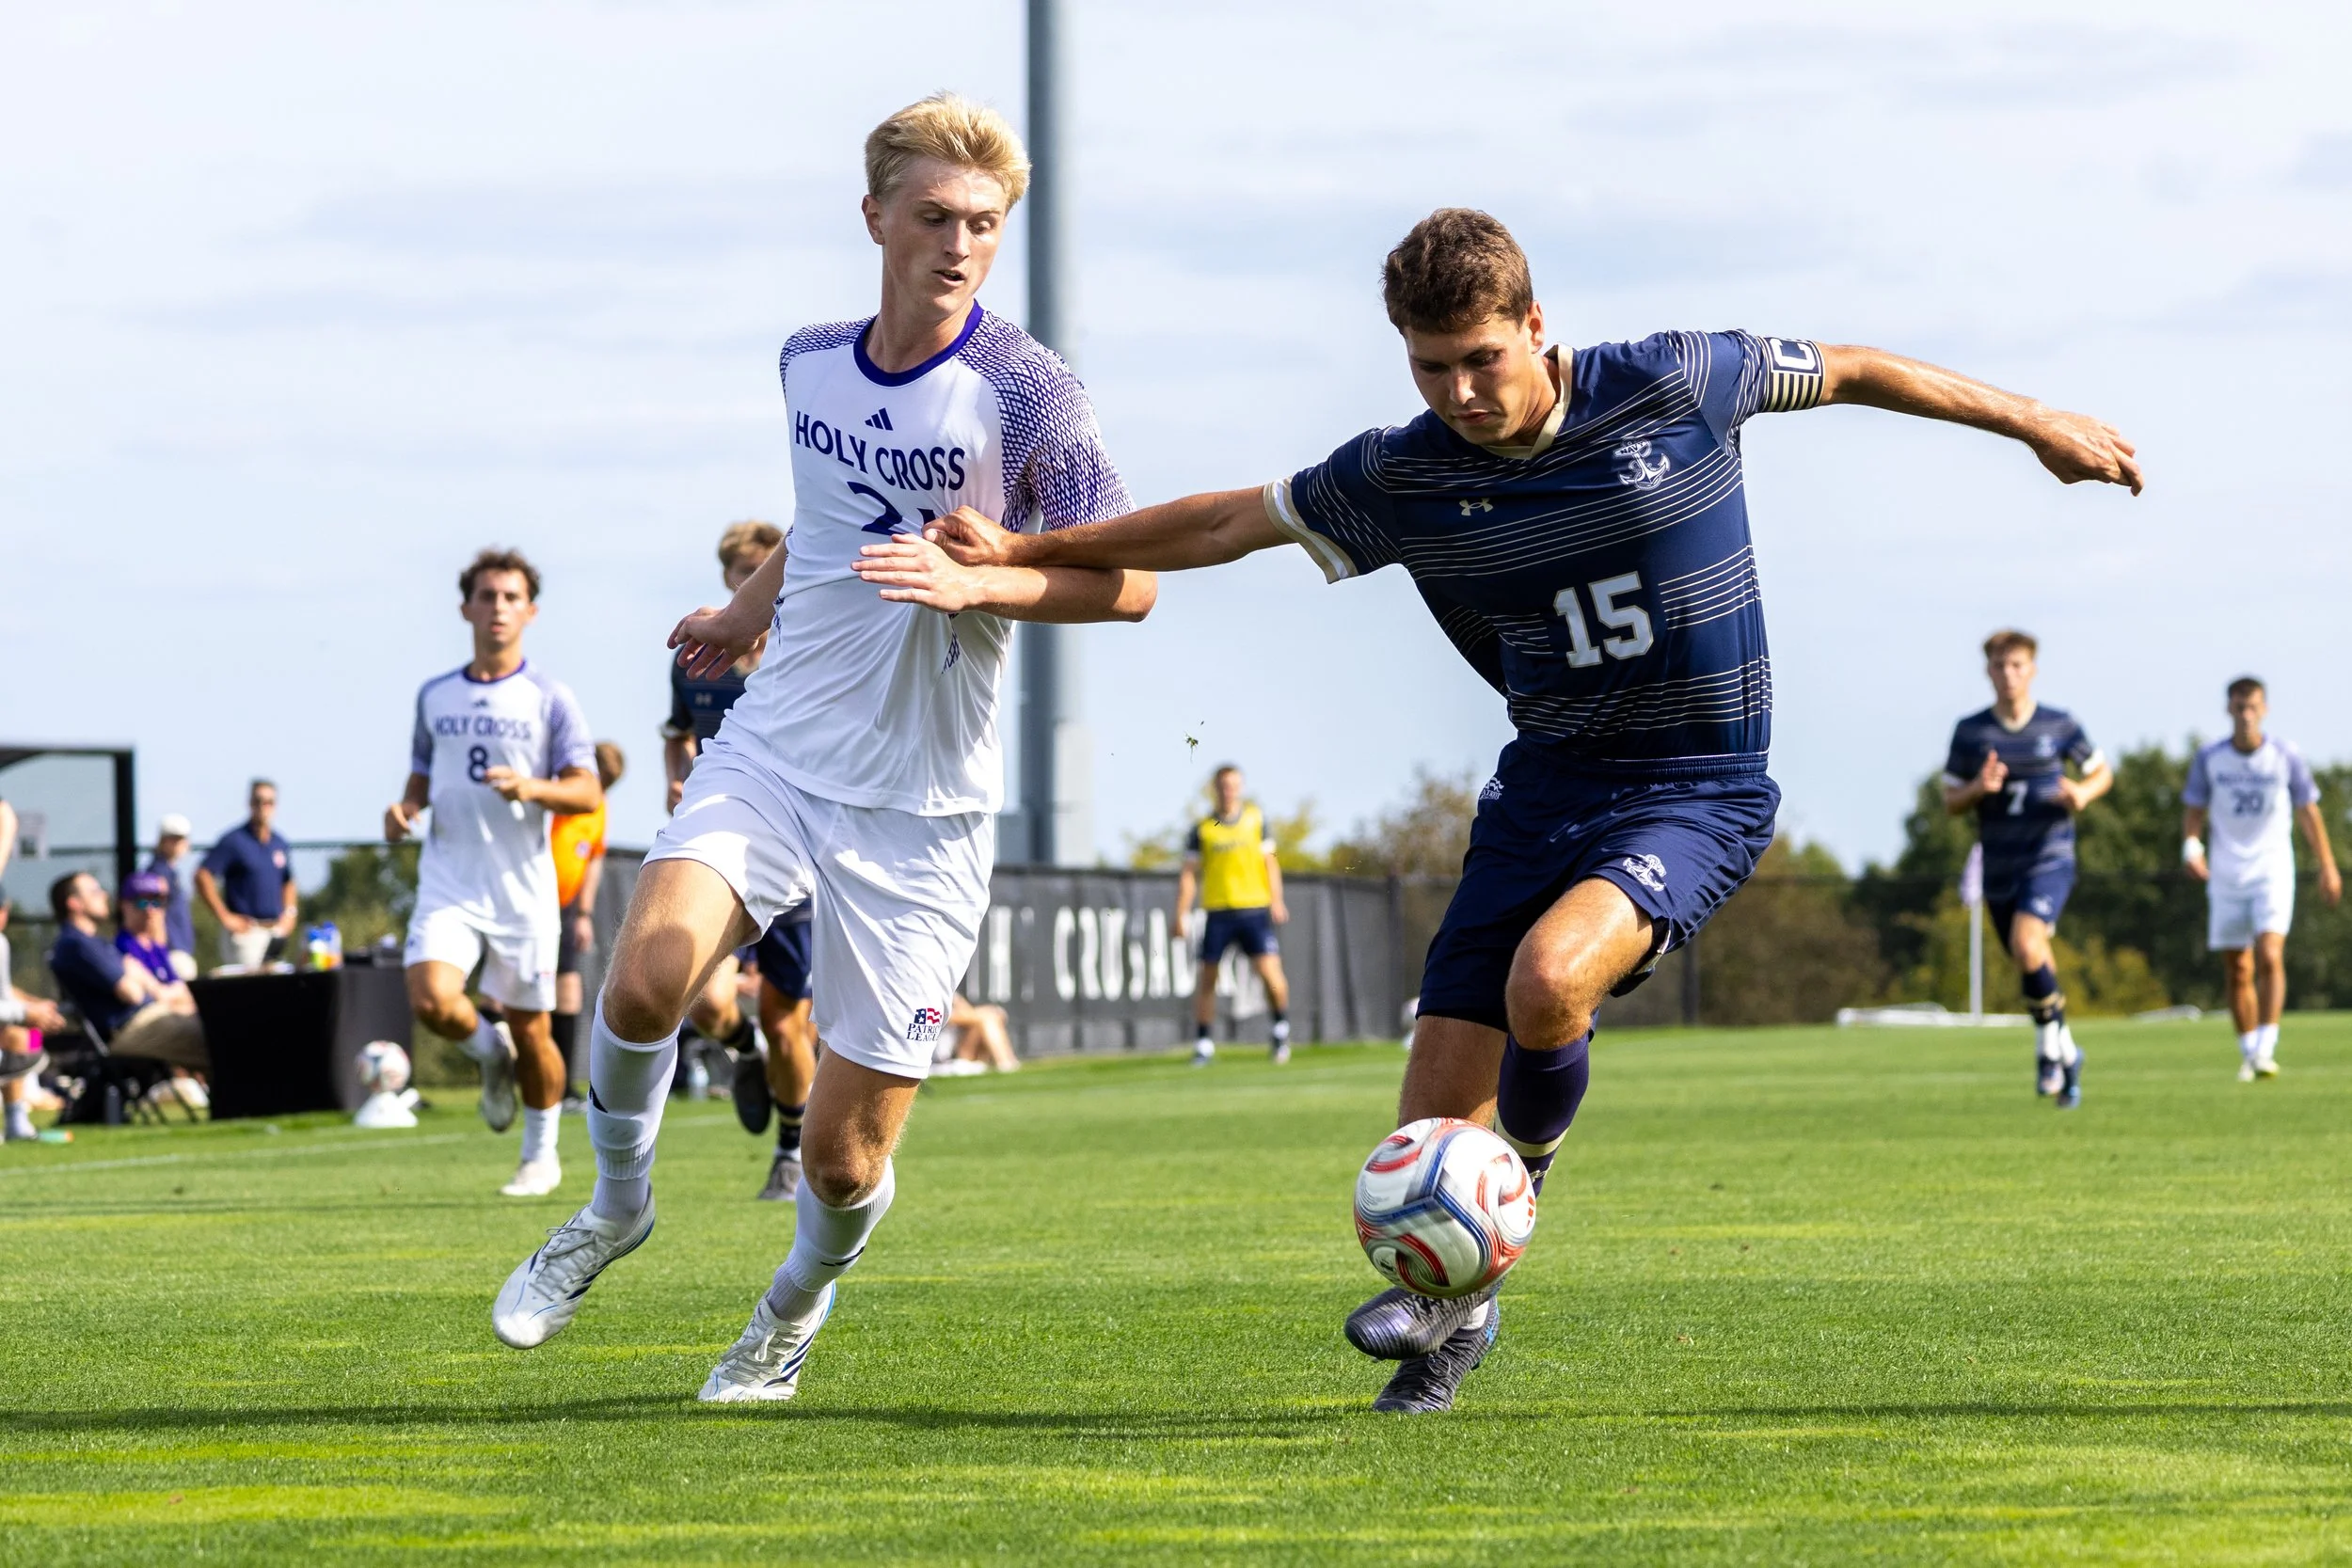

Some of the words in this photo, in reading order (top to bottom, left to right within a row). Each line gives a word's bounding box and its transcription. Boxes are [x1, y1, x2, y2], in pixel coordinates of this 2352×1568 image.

[796, 410, 868, 474] HOLY
[875, 447, 965, 491] CROSS
[1553, 571, 1654, 668] 15
[469, 745, 488, 783] 8
[2006, 781, 2028, 816] 7
